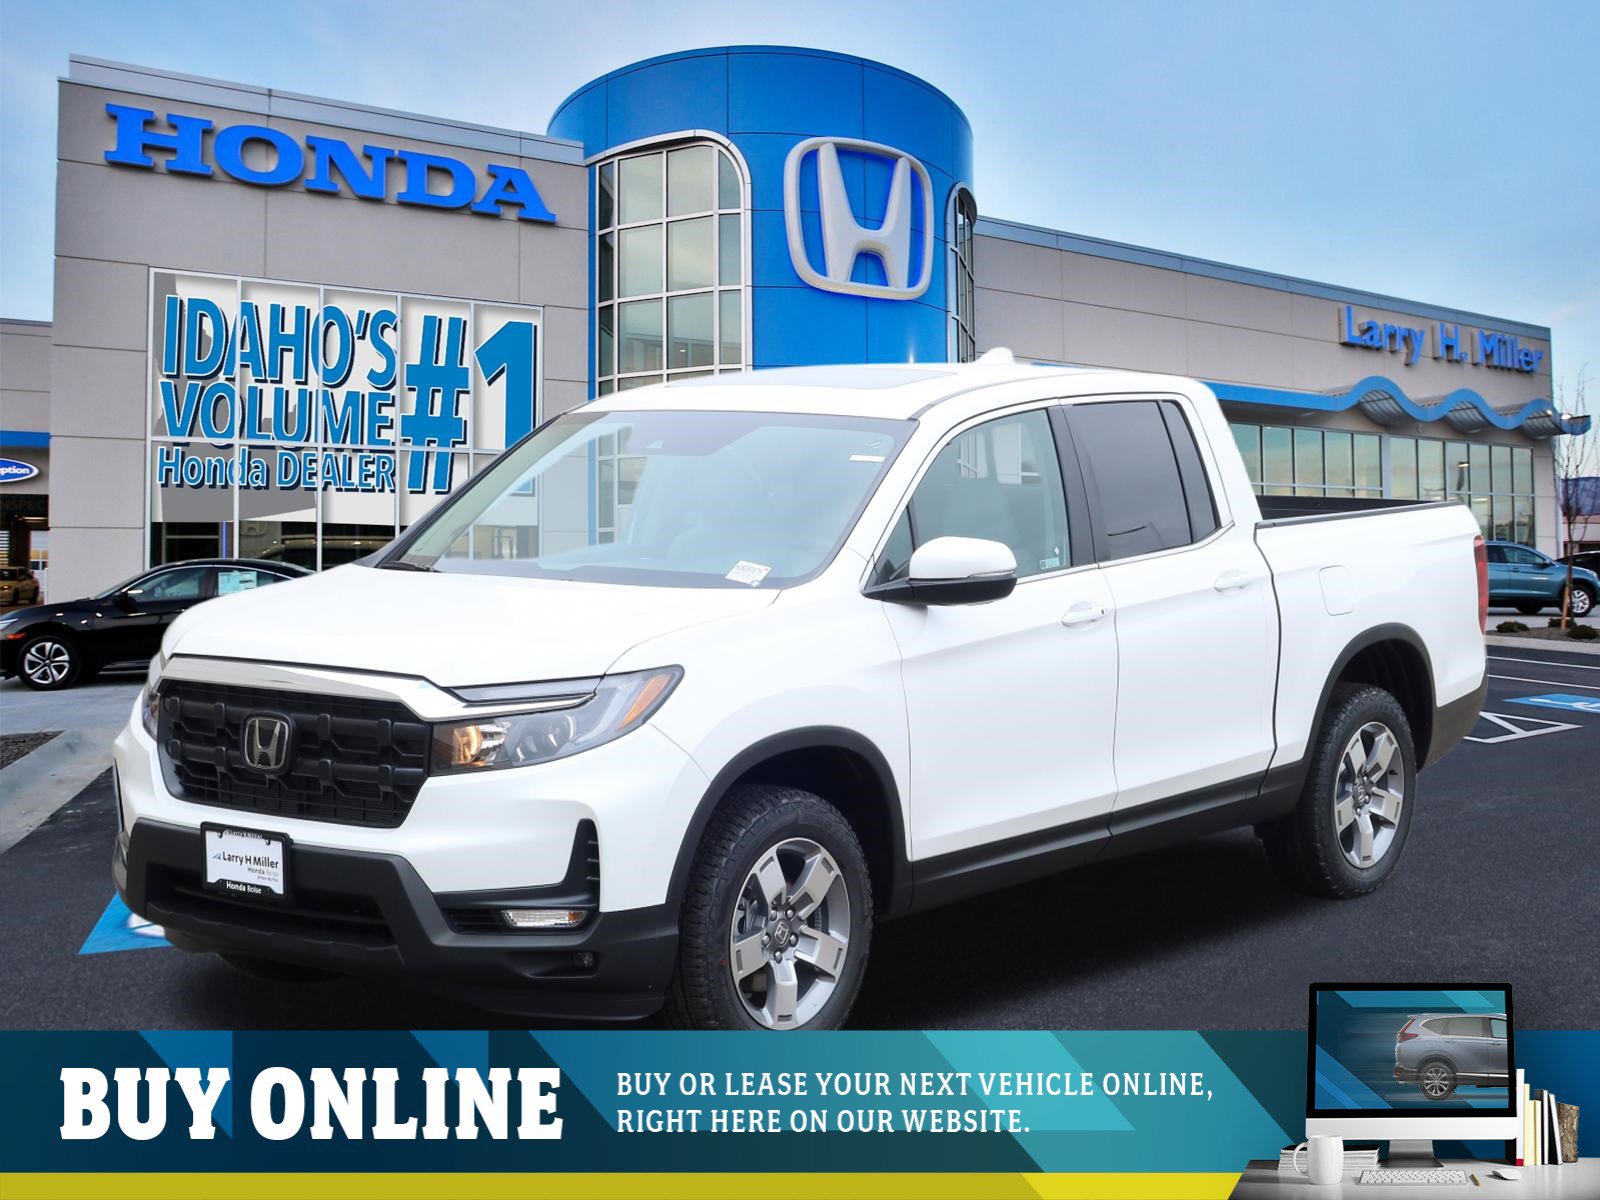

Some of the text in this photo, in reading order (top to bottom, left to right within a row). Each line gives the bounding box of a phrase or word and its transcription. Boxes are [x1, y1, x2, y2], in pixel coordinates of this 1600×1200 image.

[104, 103, 557, 223] HONDA
[163, 294, 398, 388] IDAHO'S
[1344, 304, 1545, 373] Larry H. Miller
[159, 380, 396, 449] VOLUME
[157, 446, 396, 493] Honda DEALER
[222, 851, 279, 869] Larry H Miller
[226, 880, 246, 892] Honda
